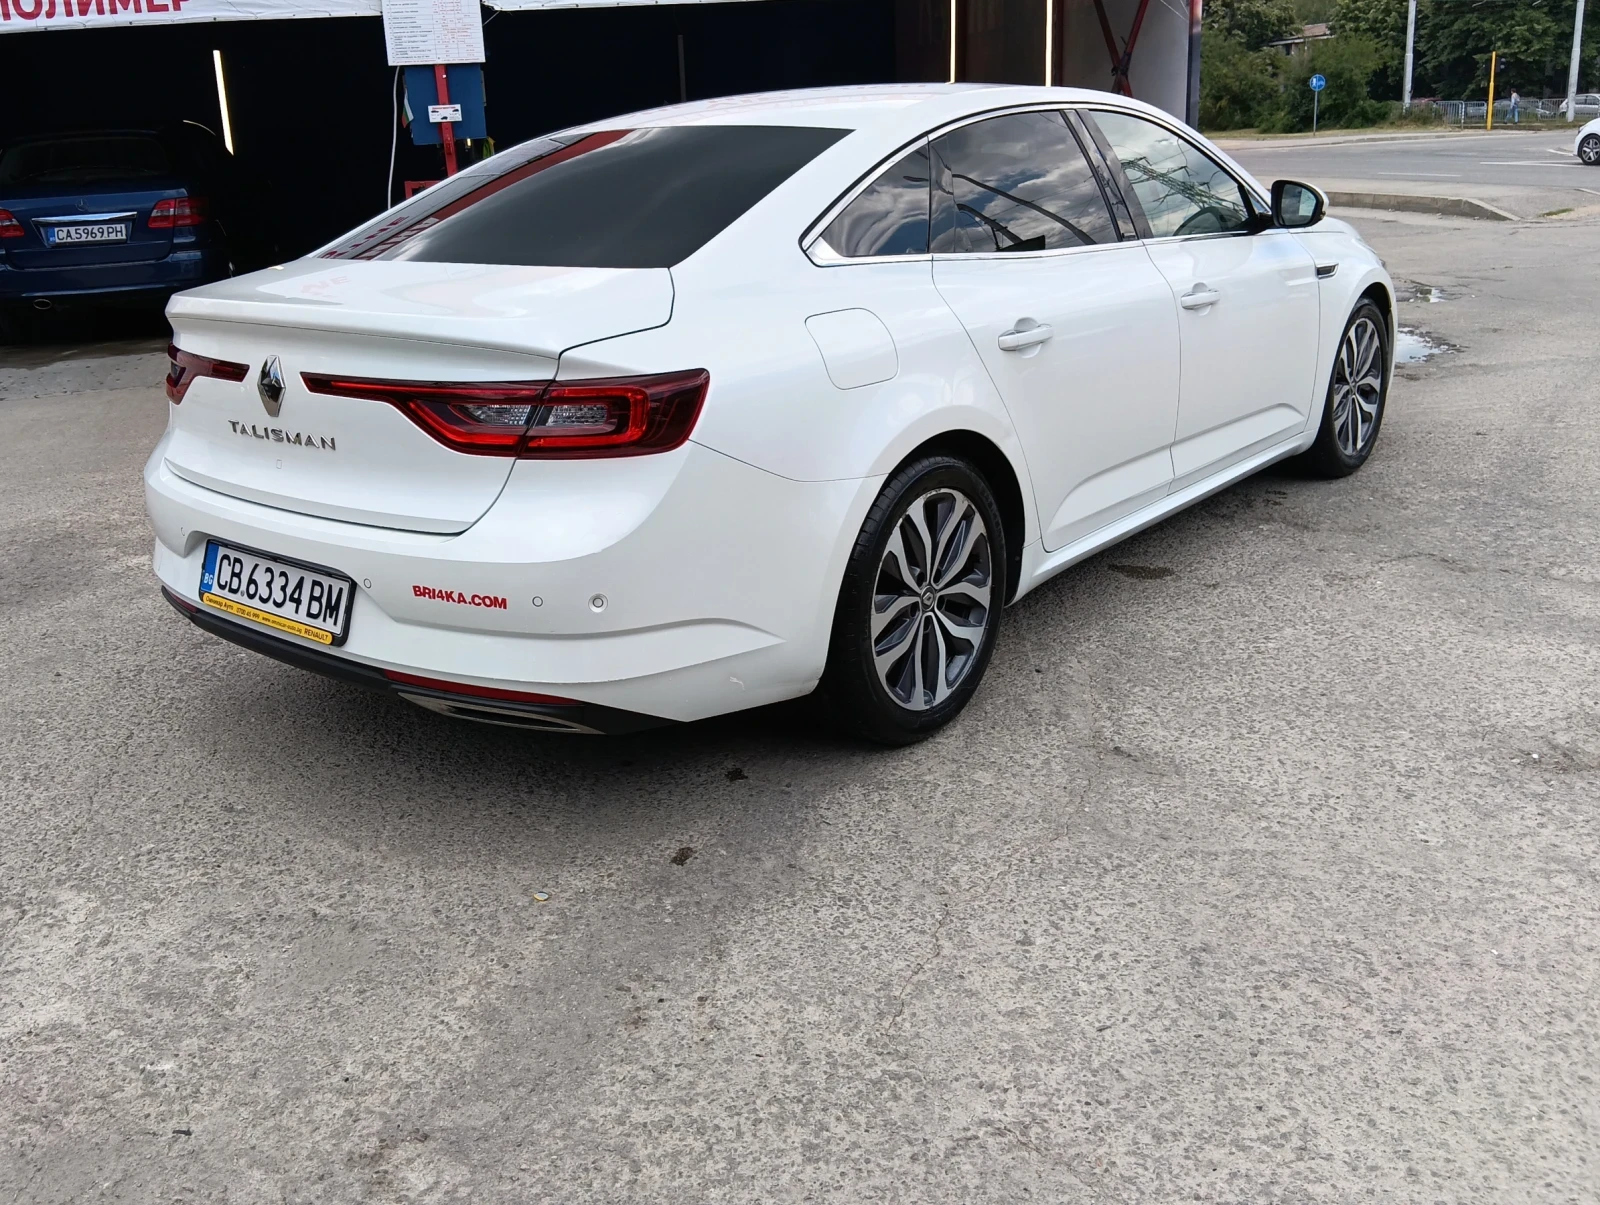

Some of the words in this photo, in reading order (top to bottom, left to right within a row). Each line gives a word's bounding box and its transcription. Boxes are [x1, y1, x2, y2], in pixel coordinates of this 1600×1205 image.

[0, 0, 191, 21] ОЛИМ
[228, 420, 336, 451] TALISMAN
[203, 572, 214, 585] BG
[412, 585, 507, 610] BRI4KA.COM
[304, 627, 329, 642] RENAULT
